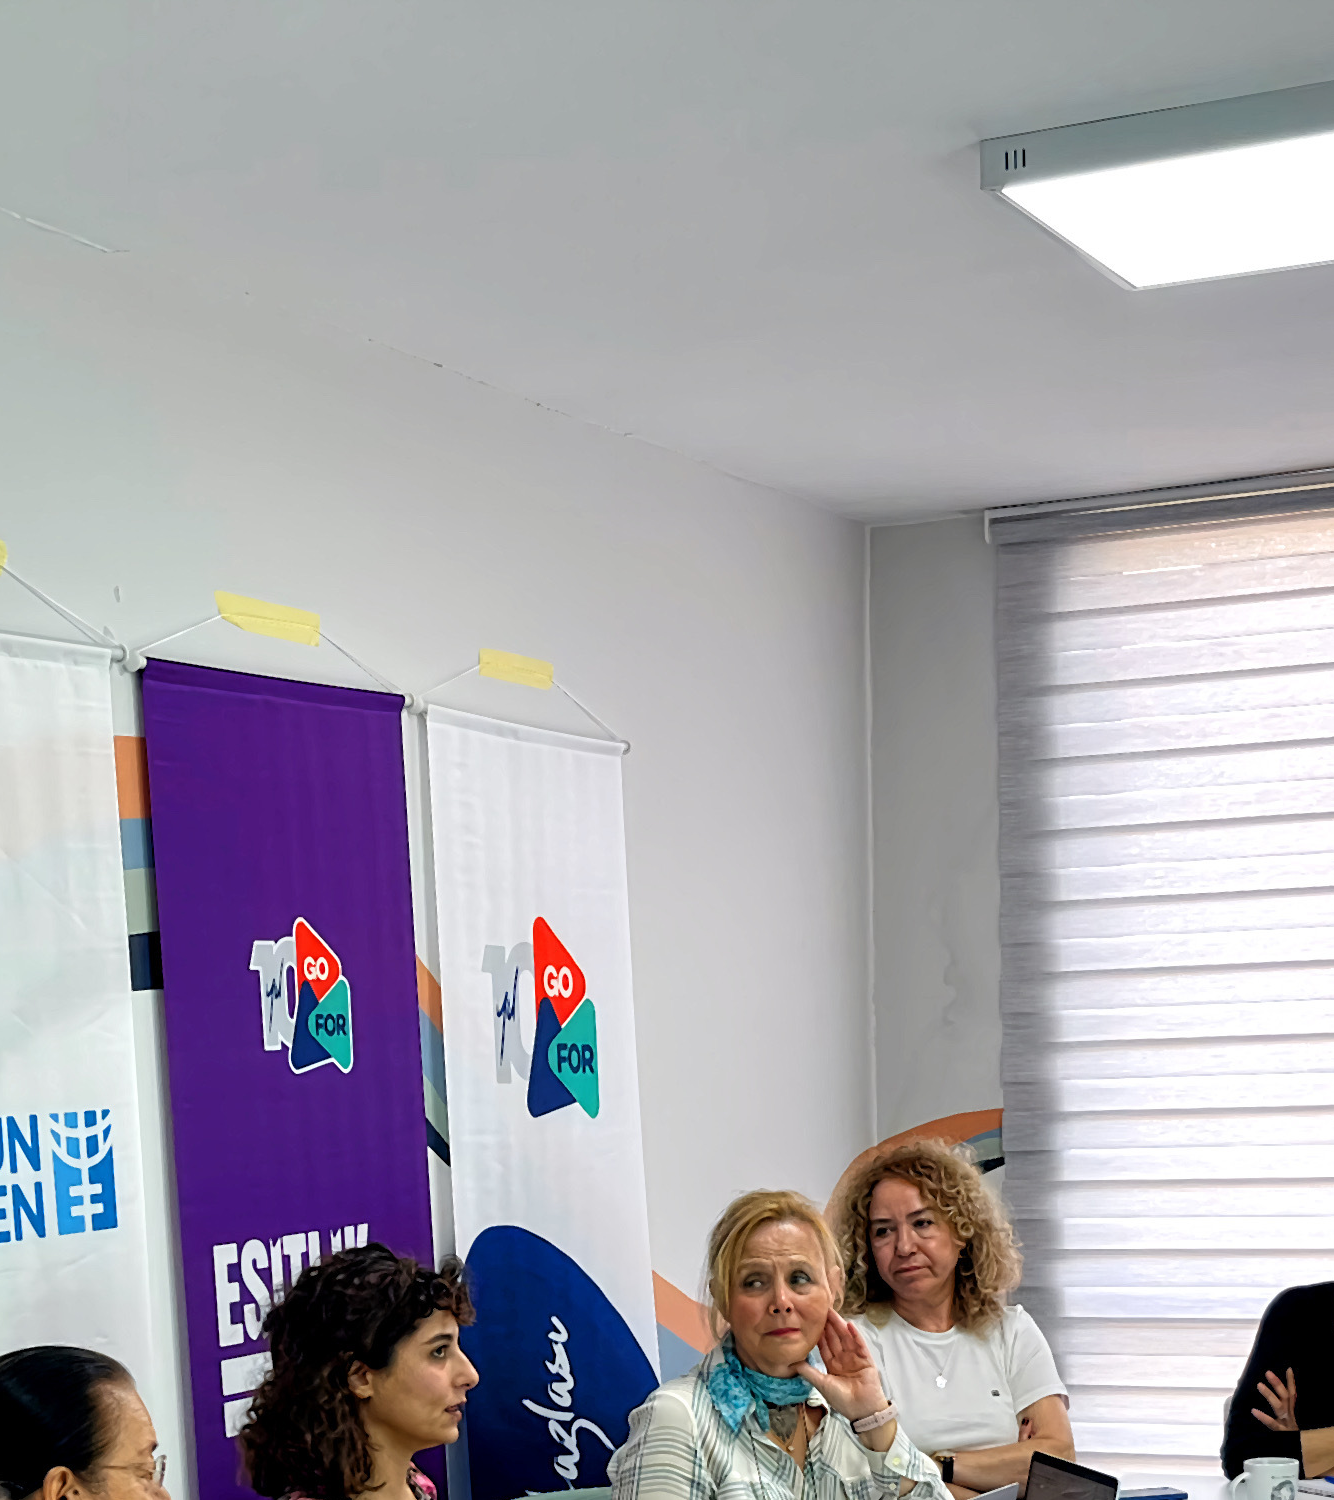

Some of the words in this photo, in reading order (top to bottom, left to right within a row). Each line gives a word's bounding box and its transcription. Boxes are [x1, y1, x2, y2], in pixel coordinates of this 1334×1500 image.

[303, 956, 329, 981] GO
[543, 965, 573, 998] GO
[315, 1013, 347, 1037] FOR
[556, 1043, 595, 1074] FOR
